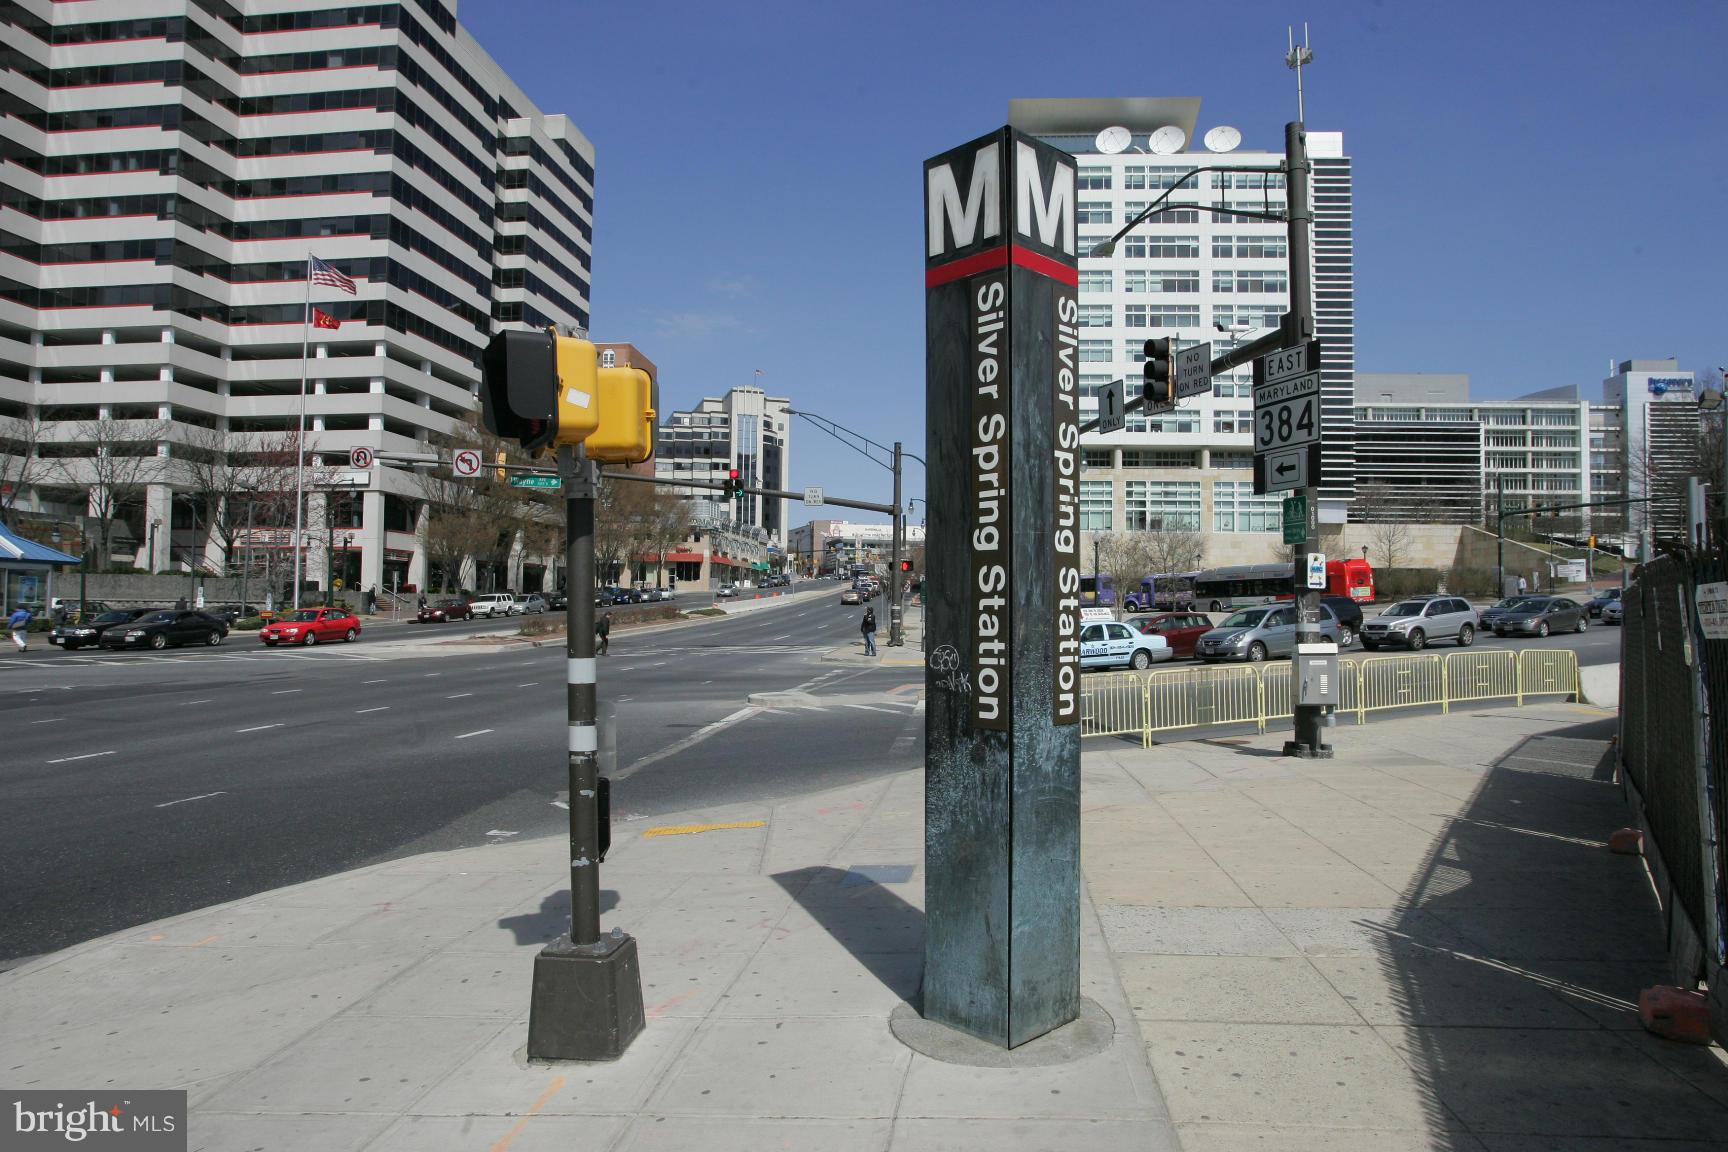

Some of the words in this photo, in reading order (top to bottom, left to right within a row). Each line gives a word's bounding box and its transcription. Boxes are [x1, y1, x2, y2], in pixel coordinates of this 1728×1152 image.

[929, 141, 1000, 257] M
[1016, 140, 1075, 257] M
[978, 282, 1004, 399] Silver
[1058, 297, 1077, 410] Silver
[1184, 364, 1204, 377] TURN
[1186, 352, 1199, 364] NO
[1268, 351, 1302, 376] EAST
[1102, 416, 1121, 429] ONLY
[1180, 382, 1190, 392] ON
[1193, 377, 1209, 387] RED
[1259, 378, 1313, 402] MARYLAND
[1260, 400, 1314, 446] 384
[973, 414, 1005, 551] Spring
[1055, 422, 1078, 553] Spring
[979, 565, 1005, 719] Station
[1059, 567, 1078, 715] Station
[1080, 647, 1108, 655] ARWOOD
